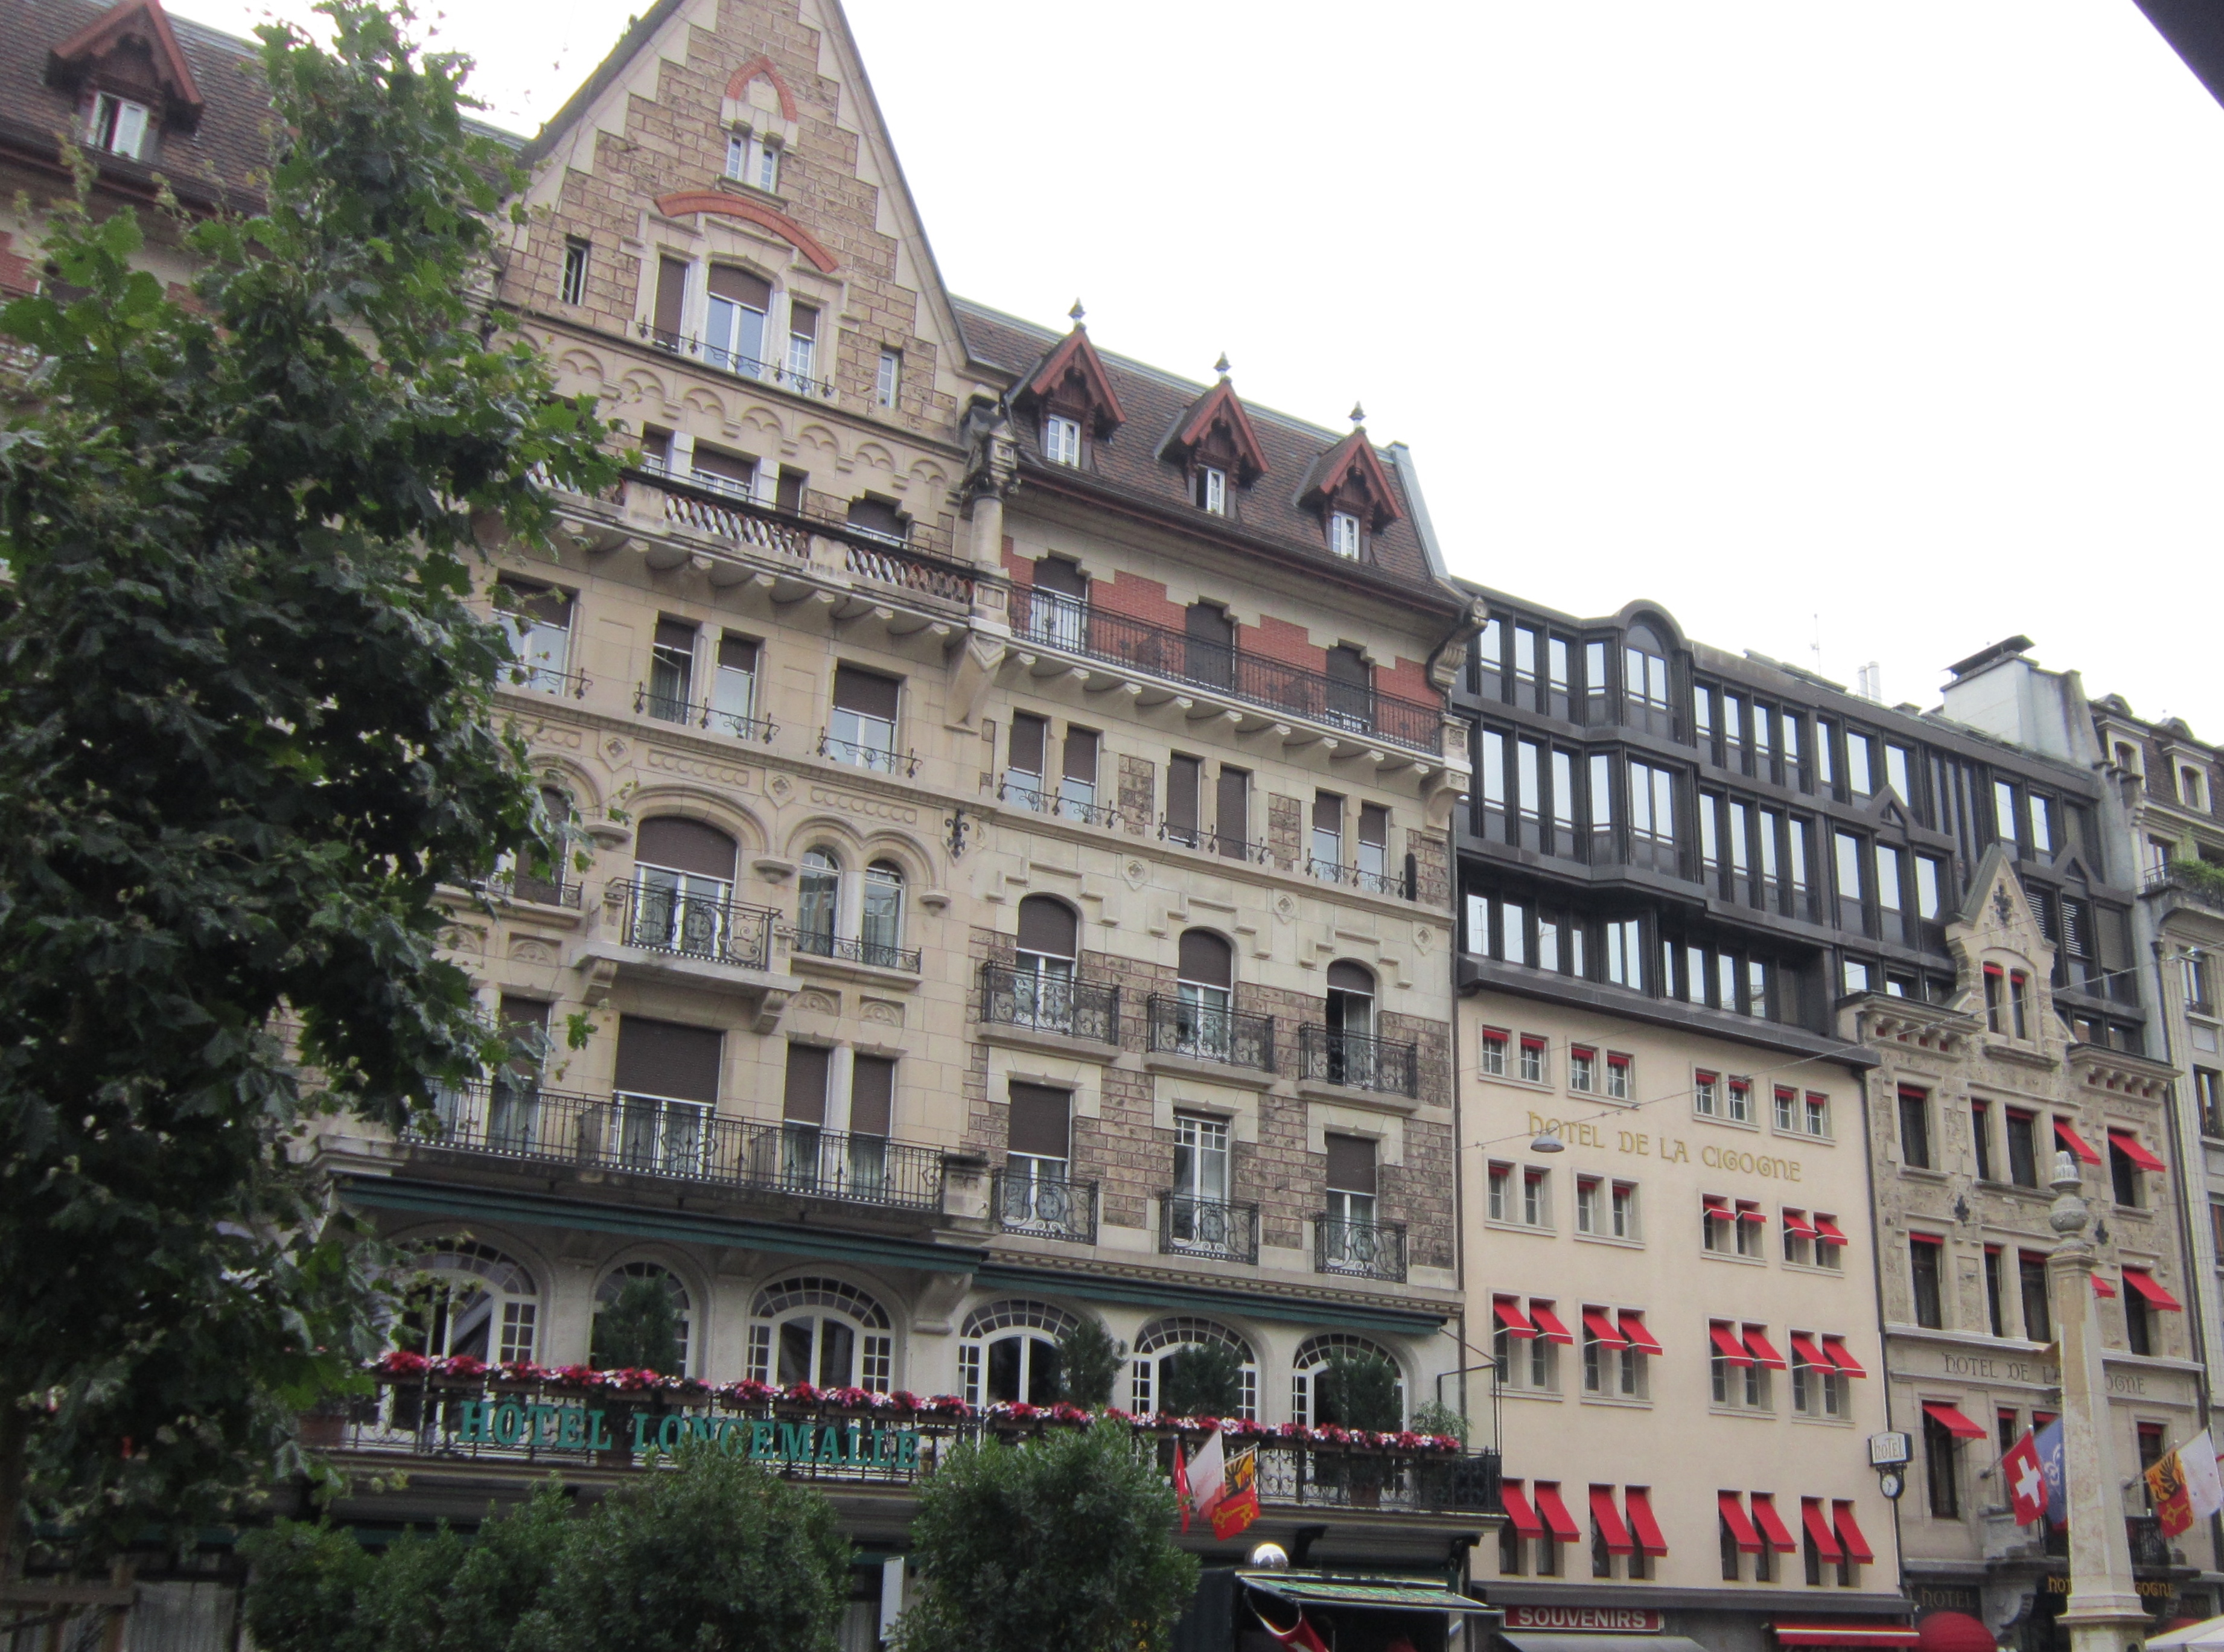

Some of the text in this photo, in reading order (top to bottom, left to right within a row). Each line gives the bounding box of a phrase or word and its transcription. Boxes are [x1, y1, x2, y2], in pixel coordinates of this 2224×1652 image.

[1618, 1131, 1649, 1155] DE
[1660, 1137, 1689, 1164] LA
[1702, 1146, 1802, 1182] CIGOGNE
[2007, 1362, 2030, 1382] DE
[457, 1394, 919, 1468] HÔTEL LONGEMALLE
[1518, 1607, 1646, 1628] SOUVENIRS
